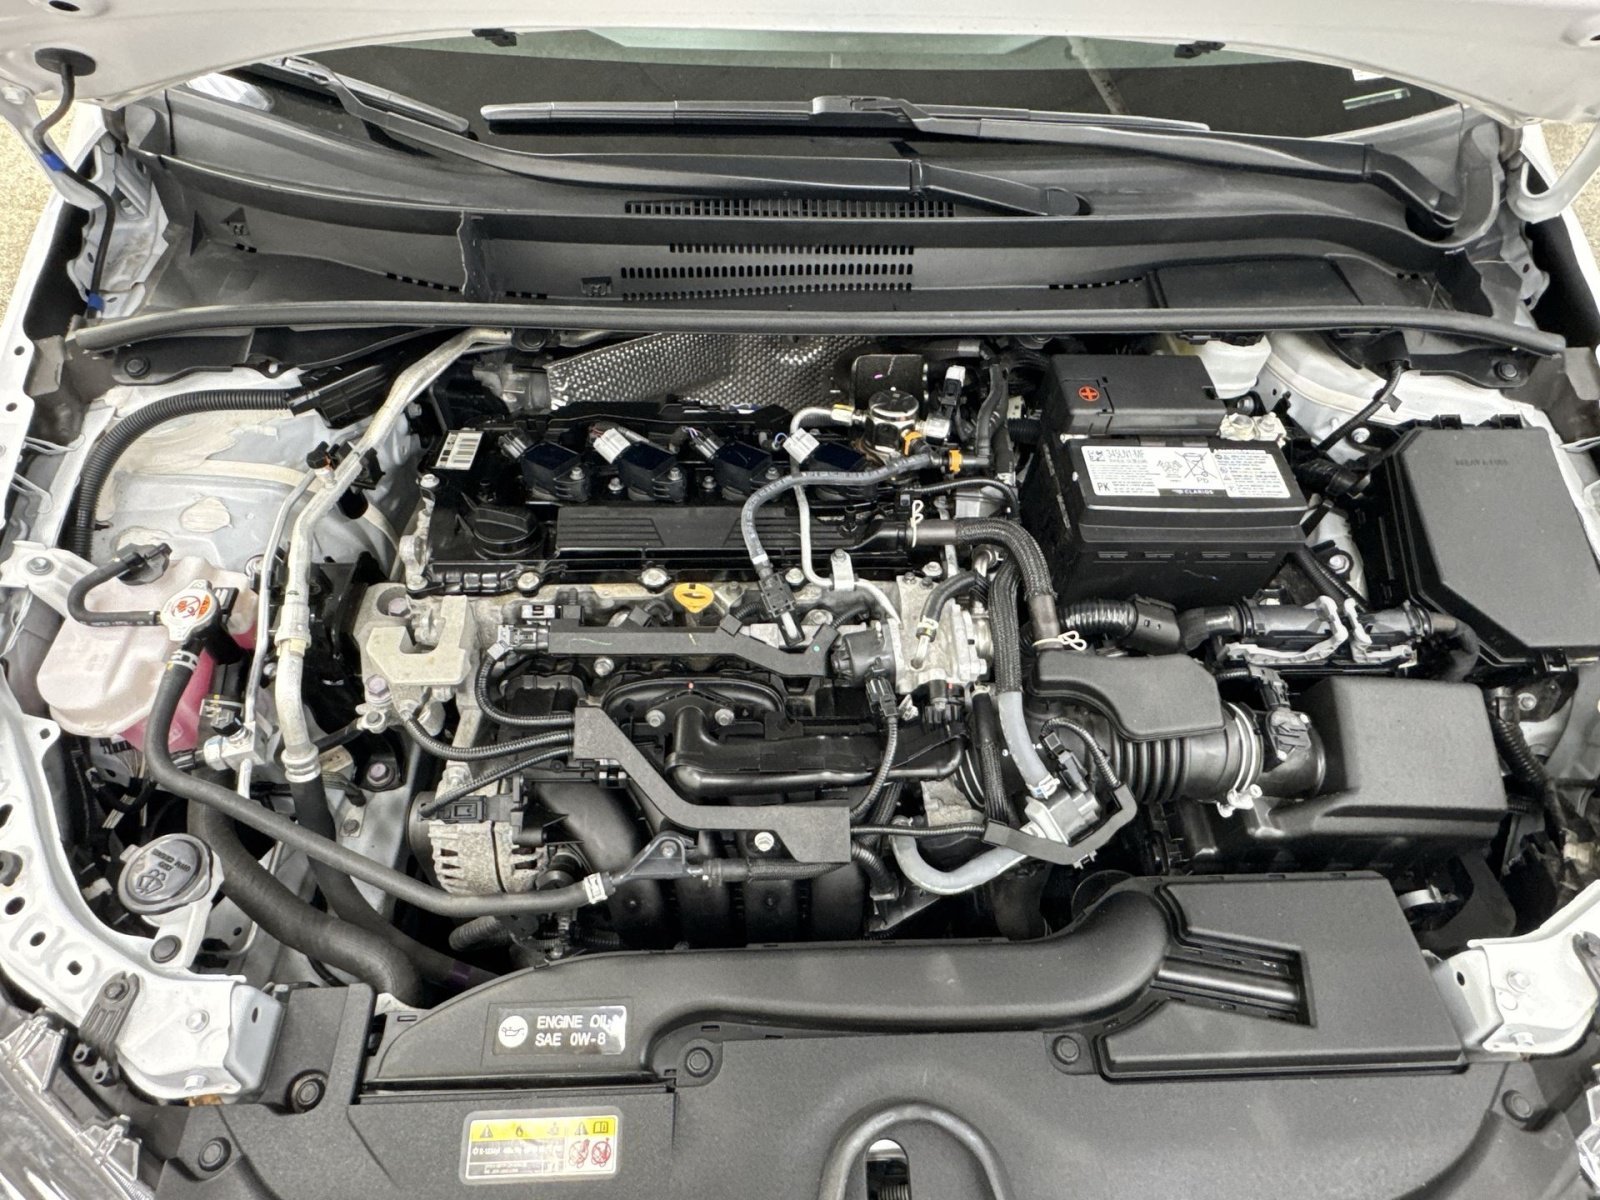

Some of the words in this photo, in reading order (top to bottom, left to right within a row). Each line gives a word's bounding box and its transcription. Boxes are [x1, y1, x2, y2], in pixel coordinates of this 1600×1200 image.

[1097, 482, 1110, 491] PK
[537, 1015, 583, 1028] ENGINE
[590, 1014, 611, 1028] OIL
[535, 1032, 562, 1046] SAE
[570, 1032, 606, 1046] 0W-8
